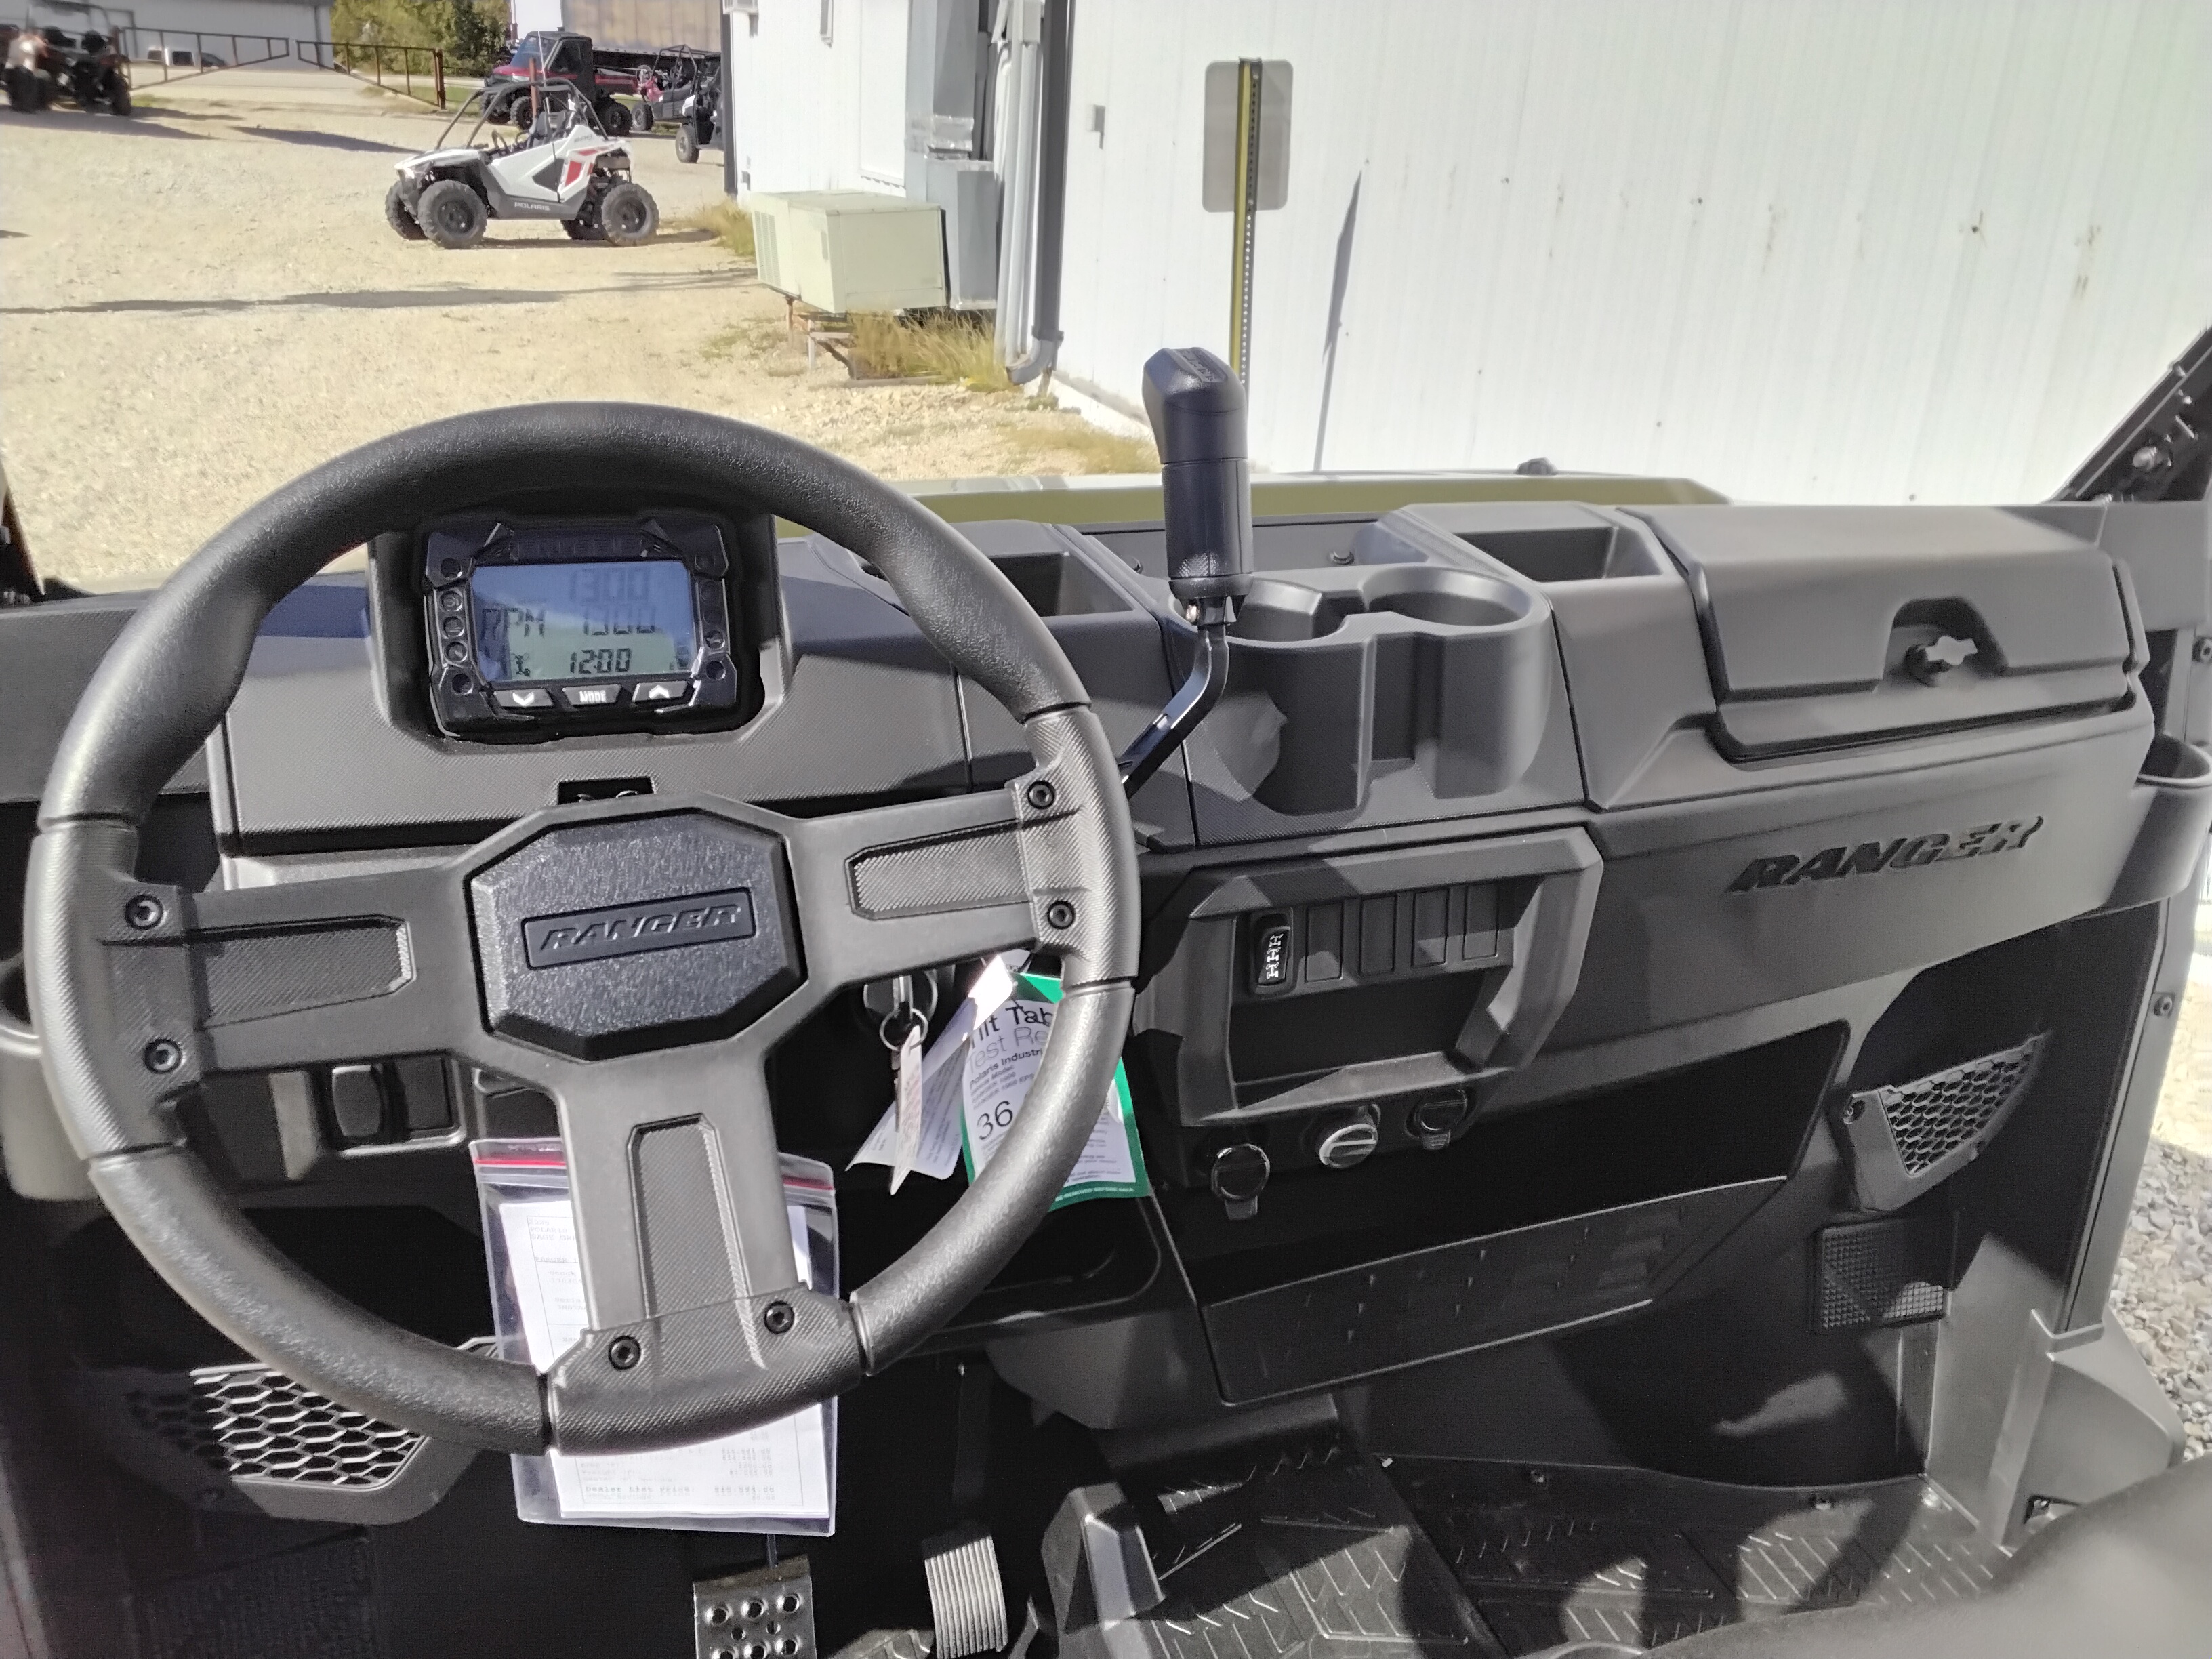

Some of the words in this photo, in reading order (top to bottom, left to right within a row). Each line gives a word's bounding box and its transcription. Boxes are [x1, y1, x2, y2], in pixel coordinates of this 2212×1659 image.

[514, 202, 550, 211] POLARIS
[580, 691, 607, 703] MODE
[1723, 815, 2045, 894] RANGER
[540, 903, 743, 951] RANGER
[968, 1034, 1008, 1074] Test
[969, 1063, 999, 1092] Polaris
